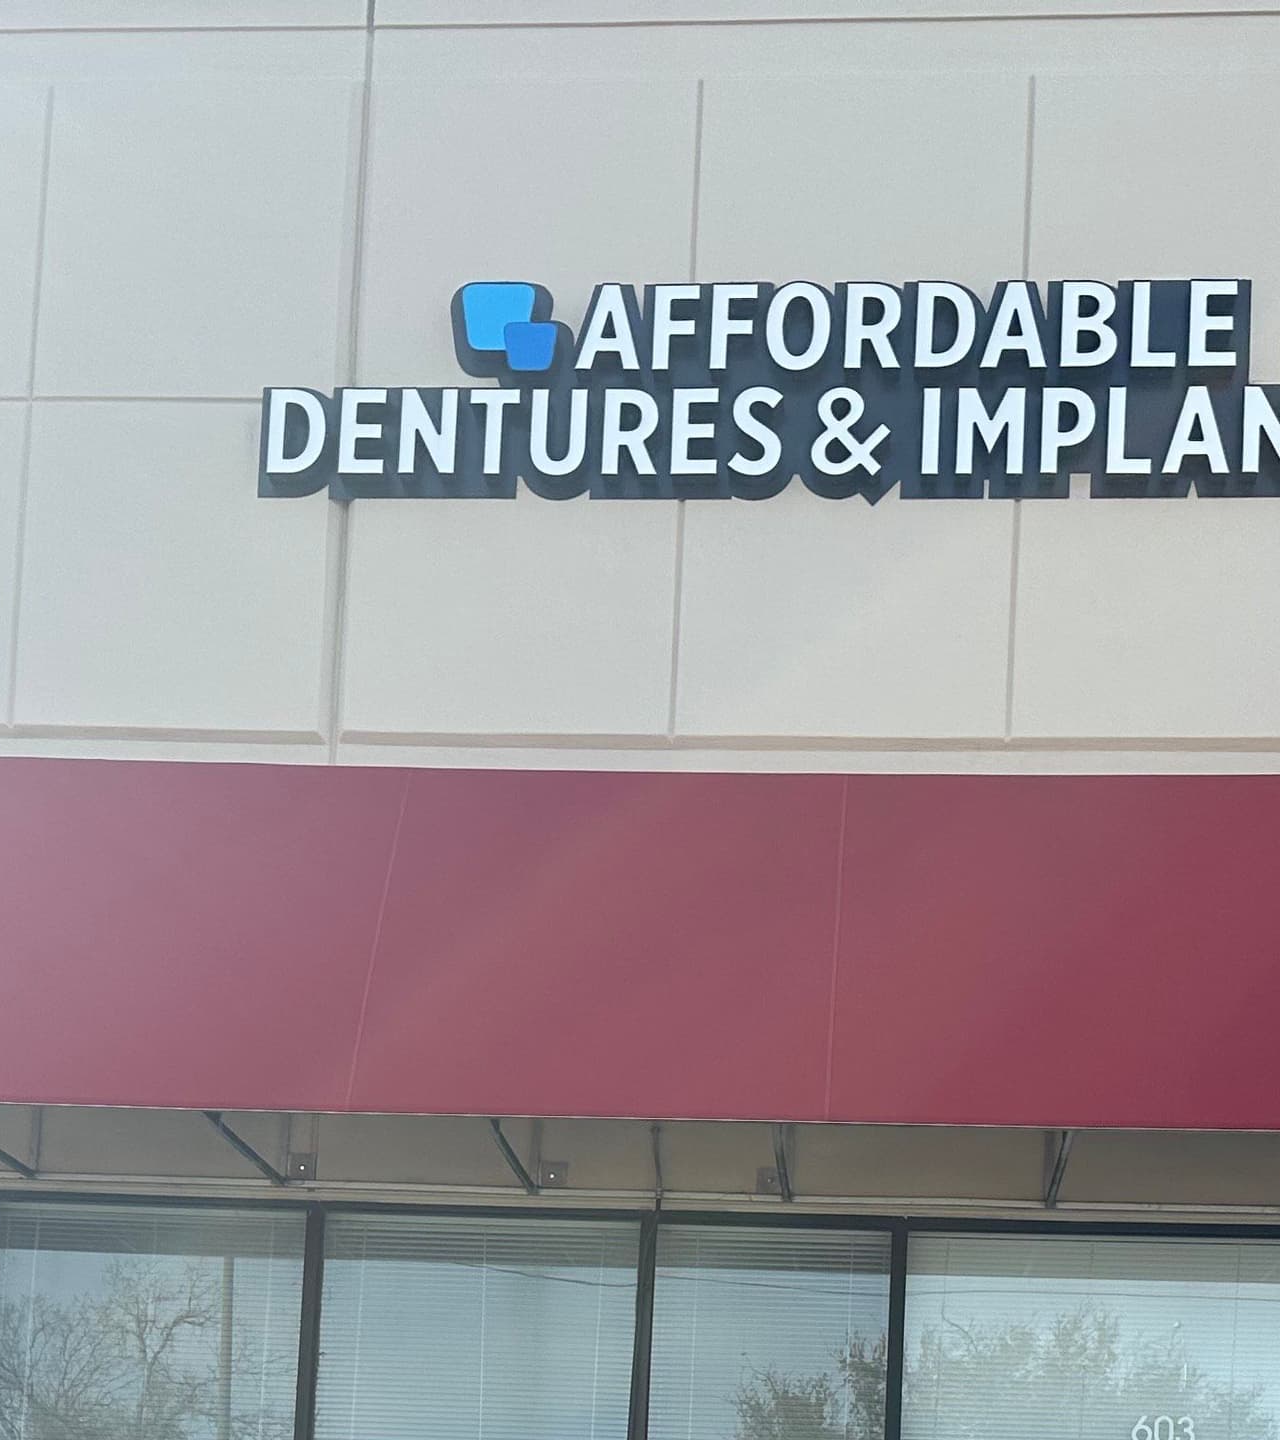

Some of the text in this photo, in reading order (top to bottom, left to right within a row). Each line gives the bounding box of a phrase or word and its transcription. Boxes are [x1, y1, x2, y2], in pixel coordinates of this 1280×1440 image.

[573, 280, 1239, 372] AFFORDABLE
[265, 385, 784, 477] DENTURES
[809, 385, 892, 479] &
